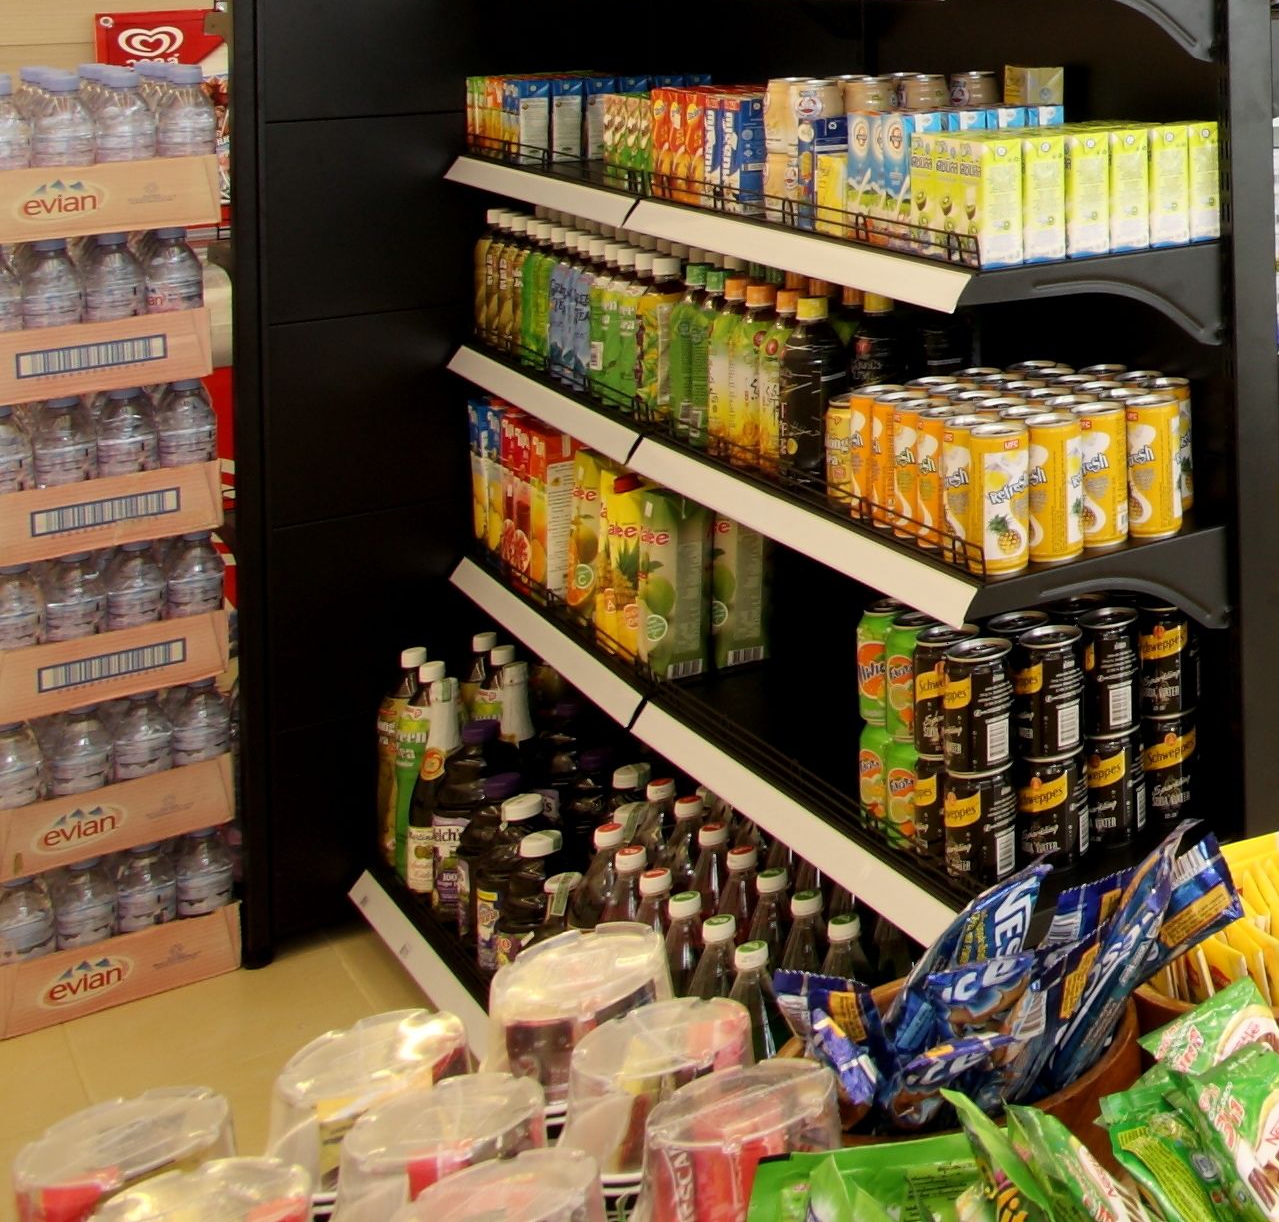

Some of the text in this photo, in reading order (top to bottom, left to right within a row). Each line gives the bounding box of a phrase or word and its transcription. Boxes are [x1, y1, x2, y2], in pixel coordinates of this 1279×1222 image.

[23, 194, 97, 216] evian
[1147, 740, 1194, 765] Schweppes
[43, 813, 117, 847] evian
[48, 965, 123, 1002] evian
